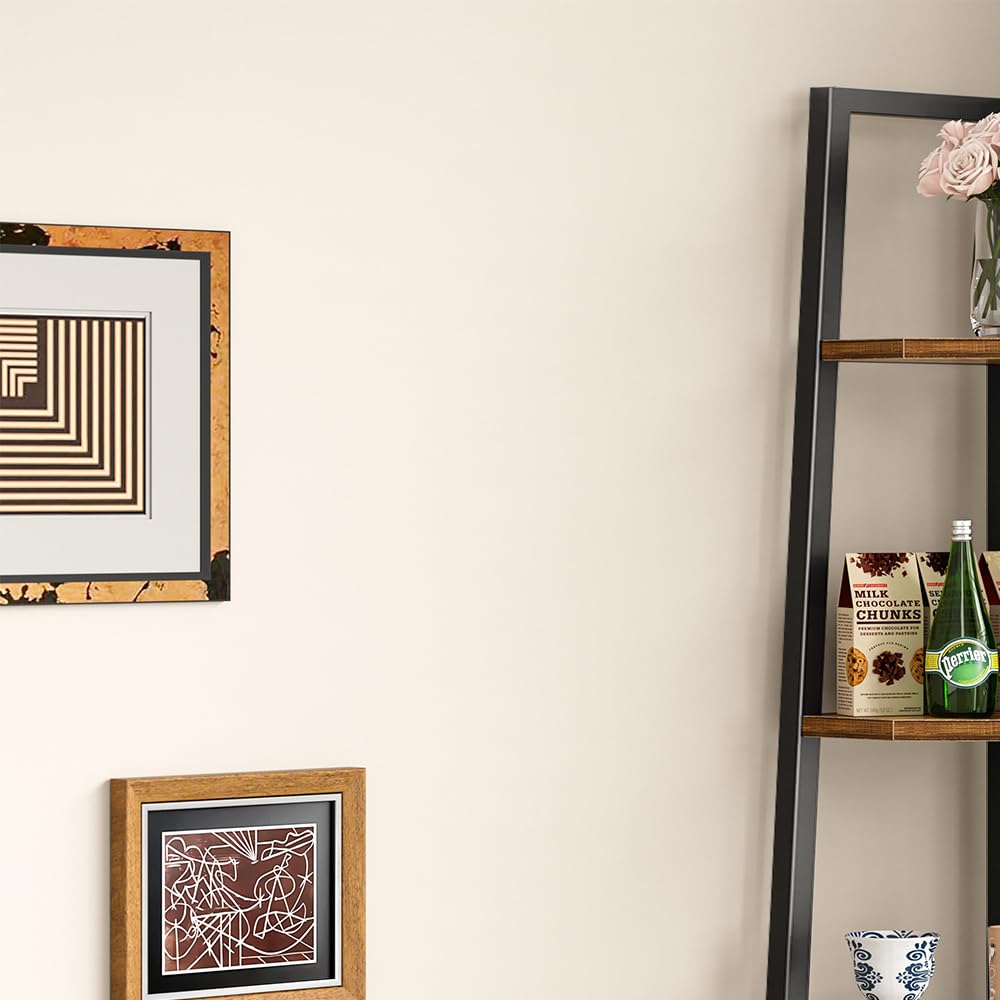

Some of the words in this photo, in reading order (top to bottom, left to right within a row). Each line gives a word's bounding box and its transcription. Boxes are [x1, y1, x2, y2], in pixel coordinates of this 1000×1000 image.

[854, 590, 889, 598] MILK
[855, 600, 921, 608] CHOCOLATE
[856, 609, 921, 620] CHUNKS
